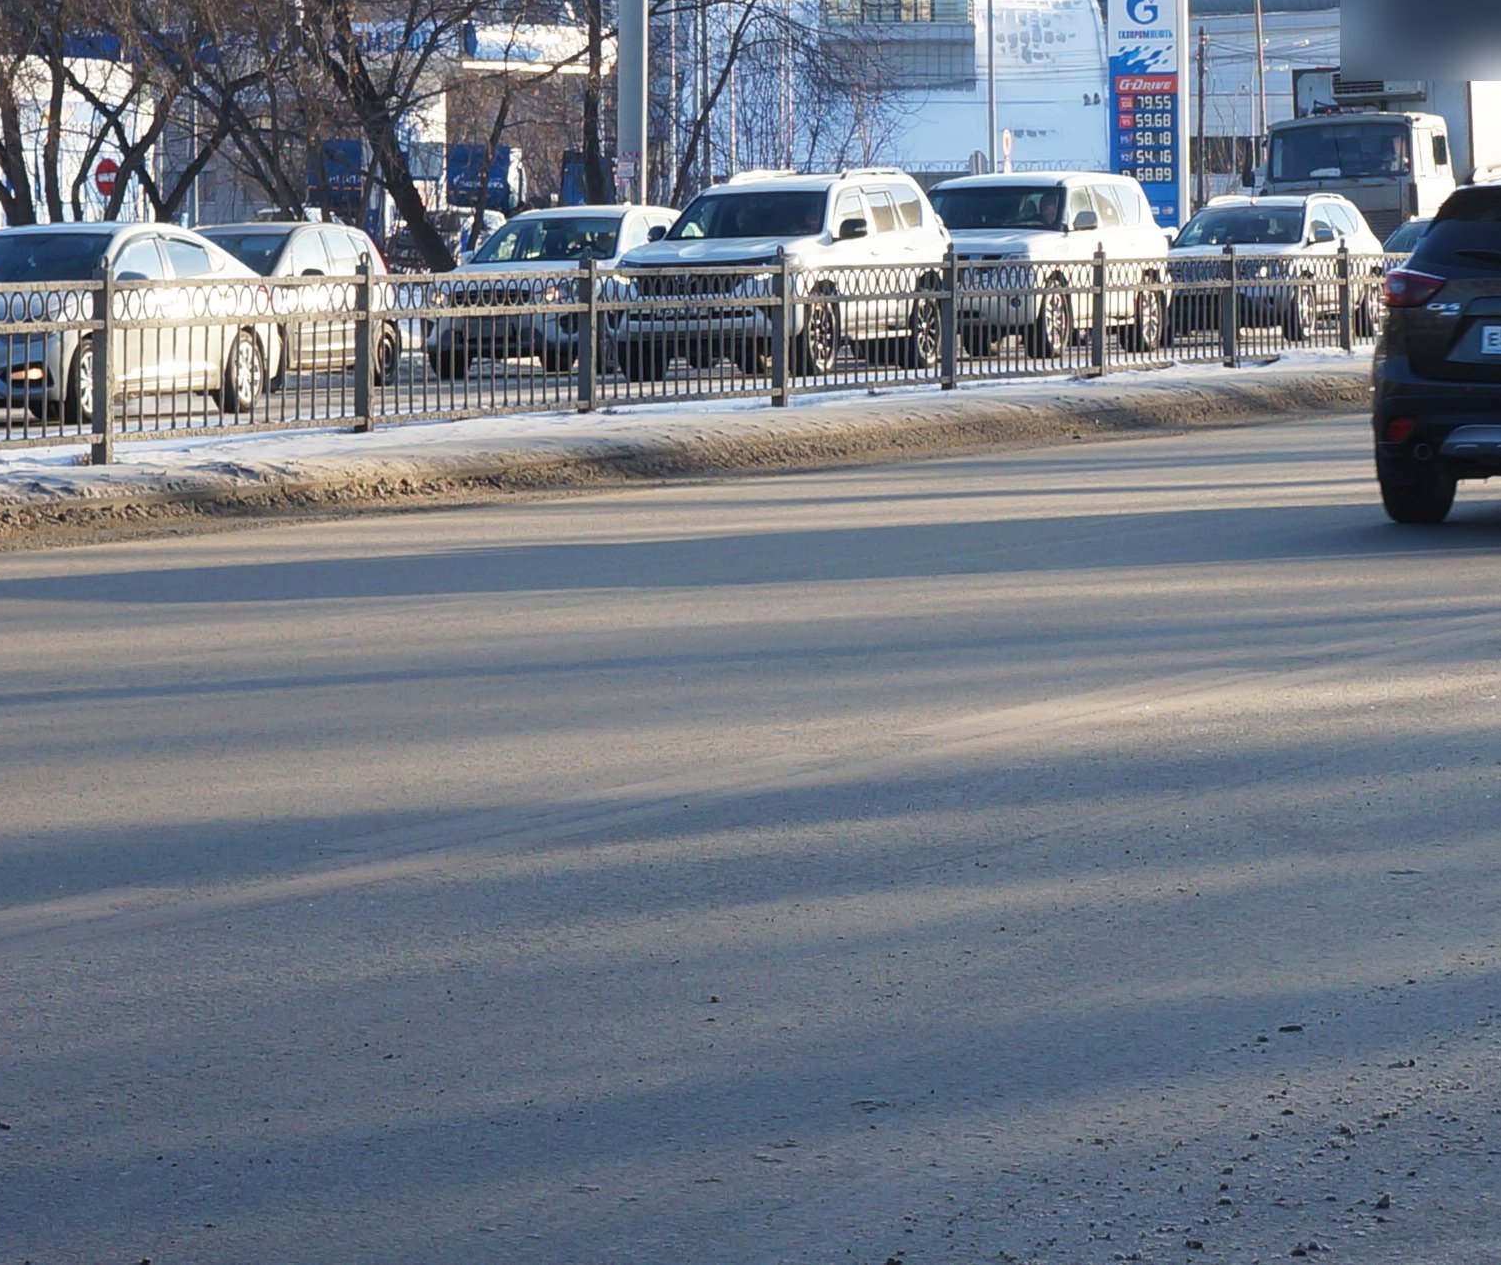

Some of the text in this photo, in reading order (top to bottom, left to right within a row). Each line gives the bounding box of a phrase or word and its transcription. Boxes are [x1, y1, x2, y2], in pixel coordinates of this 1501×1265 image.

[1136, 95, 1172, 110] 79.55
[1135, 113, 1172, 128] 59.68
[1135, 131, 1172, 146] 58.18
[1136, 149, 1172, 164] 54.16
[1136, 167, 1172, 182] 68.89
